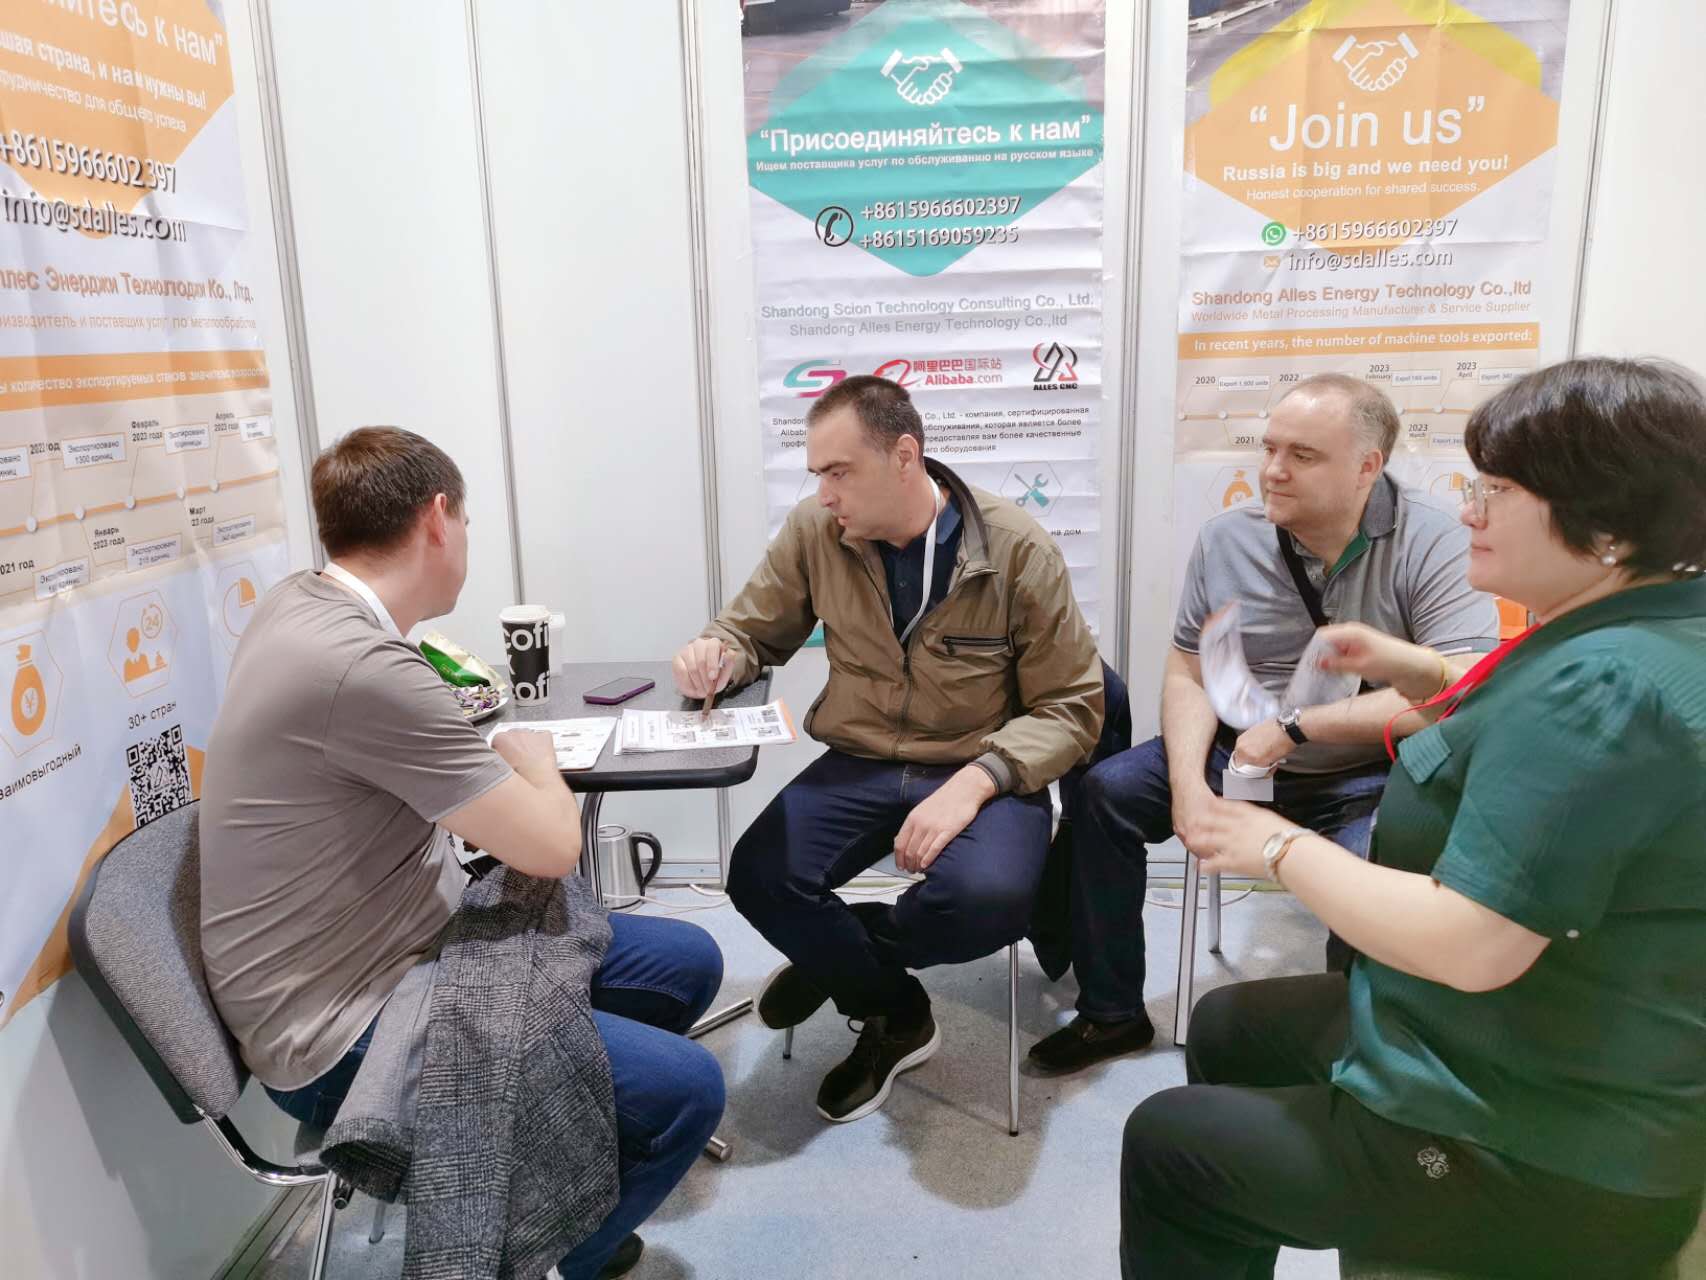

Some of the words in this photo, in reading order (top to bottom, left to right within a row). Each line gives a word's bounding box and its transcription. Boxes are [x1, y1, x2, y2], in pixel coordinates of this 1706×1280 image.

[154, 16, 168, 47] к
[97, 62, 108, 80] и
[1249, 101, 1379, 151] “Join
[1403, 95, 1486, 145] us”
[760, 122, 1001, 156] “Присоединяйтесь
[1009, 123, 1023, 142] к
[1031, 114, 1090, 141] нам”
[0, 129, 176, 193] +8615966602397
[756, 161, 787, 171] Ищем
[790, 159, 855, 171] поставщика
[858, 157, 888, 169] услуг
[891, 156, 905, 166] по
[994, 153, 1008, 161] на
[1010, 151, 1056, 163] русском
[1060, 148, 1094, 158] языке
[1223, 165, 1286, 182] Russia
[1292, 163, 1307, 178] is
[1313, 161, 1341, 181] big
[1347, 160, 1381, 176] and
[1388, 162, 1412, 174] we
[1419, 157, 1462, 173] need
[1467, 154, 1509, 175] you!
[1247, 188, 1289, 201] Honest
[1292, 184, 1362, 200] cooperation
[1365, 183, 1381, 196] for
[1385, 181, 1427, 195] shared
[1430, 181, 1481, 194] success.
[2, 188, 187, 242] info@sdalles.com
[861, 196, 1021, 220] +8615966602397
[860, 226, 1019, 248] +8615169059235
[1293, 218, 1459, 242] +8615966602397
[1288, 247, 1454, 272] info@sdalles.com
[45, 266, 118, 298] Энерджи
[1192, 289, 1273, 307] Shandong
[1278, 287, 1317, 302] Alles
[1322, 285, 1380, 302] Energy
[1385, 281, 1476, 300] Technology
[761, 305, 830, 319] Shandong
[834, 303, 871, 316] Scion
[876, 299, 954, 314] Technology
[958, 296, 1031, 311] Consulting
[1192, 309, 1249, 322] Worldwide
[1252, 308, 1283, 321] Metal
[1287, 306, 1349, 320] Processing
[1353, 303, 1425, 317] Manufacturer
[1428, 303, 1437, 314] &
[1441, 302, 1482, 314] Service
[1486, 301, 1531, 314] Supplier
[173, 317, 187, 329] по
[790, 323, 855, 337] Shandong
[859, 321, 890, 333] Alles
[895, 319, 941, 333] Energy
[946, 316, 1021, 330] Technology
[1194, 339, 1207, 351] In
[1210, 338, 1249, 351] recent
[1252, 338, 1289, 353] years,
[1292, 335, 1313, 349] the
[1316, 333, 1366, 349] number
[1368, 332, 1383, 346] of
[1385, 331, 1436, 345] machine
[1439, 329, 1470, 344] tools
[1369, 364, 1390, 373] 2023
[1456, 361, 1477, 371] 2023
[925, 373, 1003, 386] Alibaba.com
[1060, 383, 1078, 391] CNC
[1195, 375, 1216, 385] 2020
[1279, 373, 1300, 383] 2022
[773, 416, 807, 426] Shandon
[1058, 417, 1081, 427] более
[1408, 423, 1428, 432] 2023
[982, 432, 997, 440] вам
[999, 431, 1024, 439] более
[1026, 429, 1082, 440] качественные
[1235, 435, 1256, 445] 2021
[1063, 528, 1082, 539] дом
[19, 559, 35, 571] год
[128, 712, 147, 730] 30+
[150, 700, 177, 721] стран
